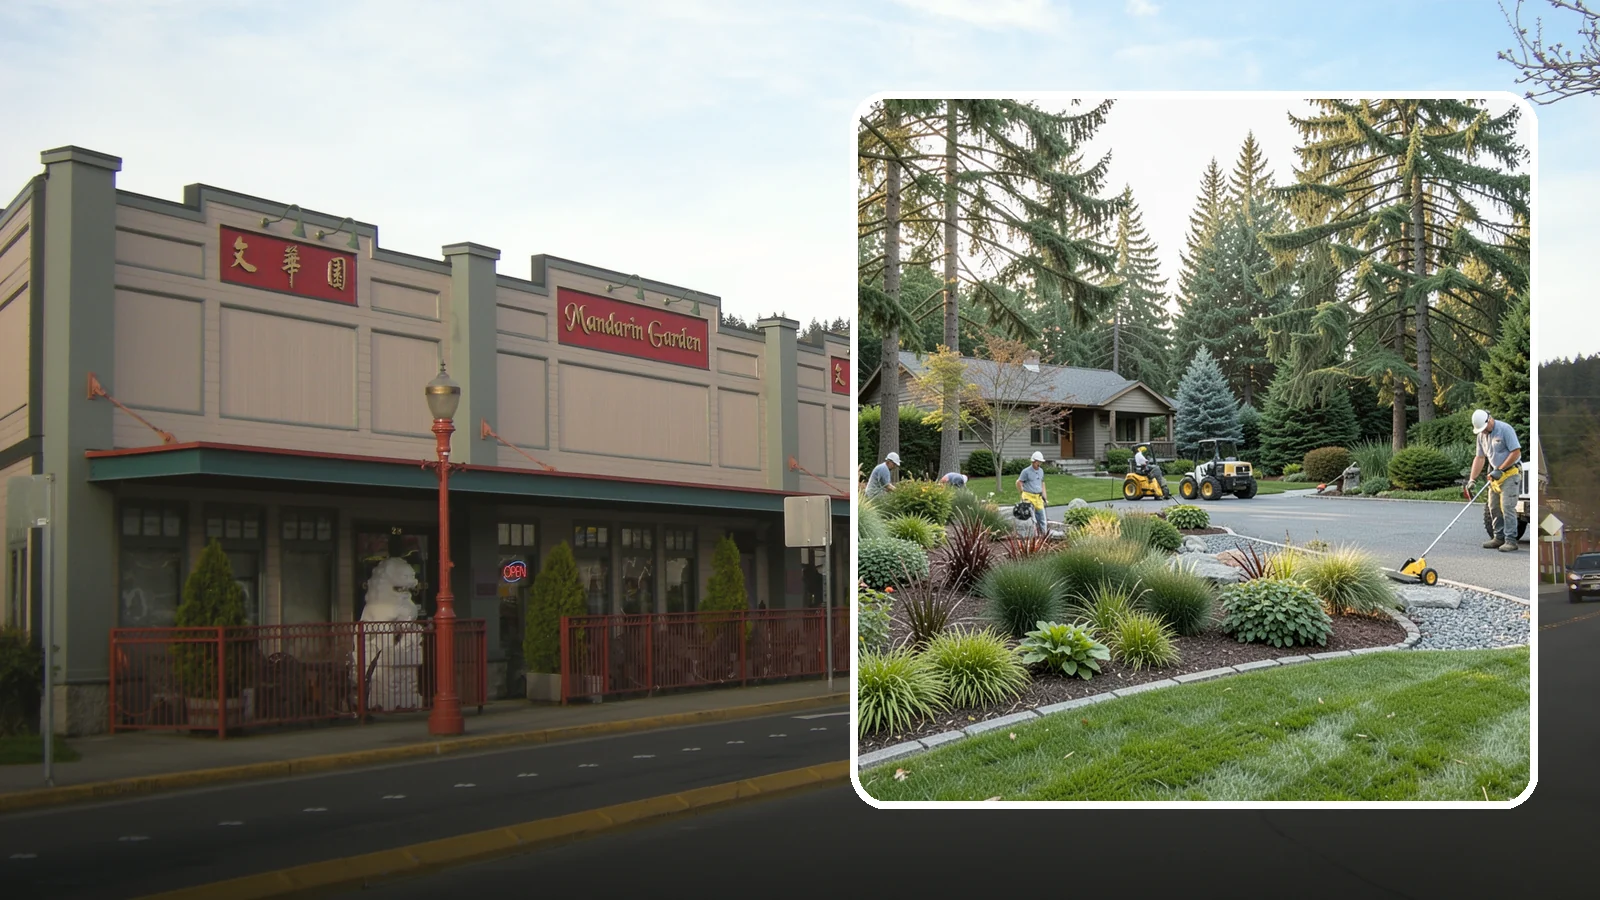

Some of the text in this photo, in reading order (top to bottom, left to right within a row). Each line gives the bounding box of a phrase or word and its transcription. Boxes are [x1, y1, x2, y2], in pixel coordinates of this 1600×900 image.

[231, 236, 346, 291] 文華園
[564, 302, 701, 352] Mandarin Garden
[834, 363, 847, 387] 文
[503, 565, 527, 578] OPEN
